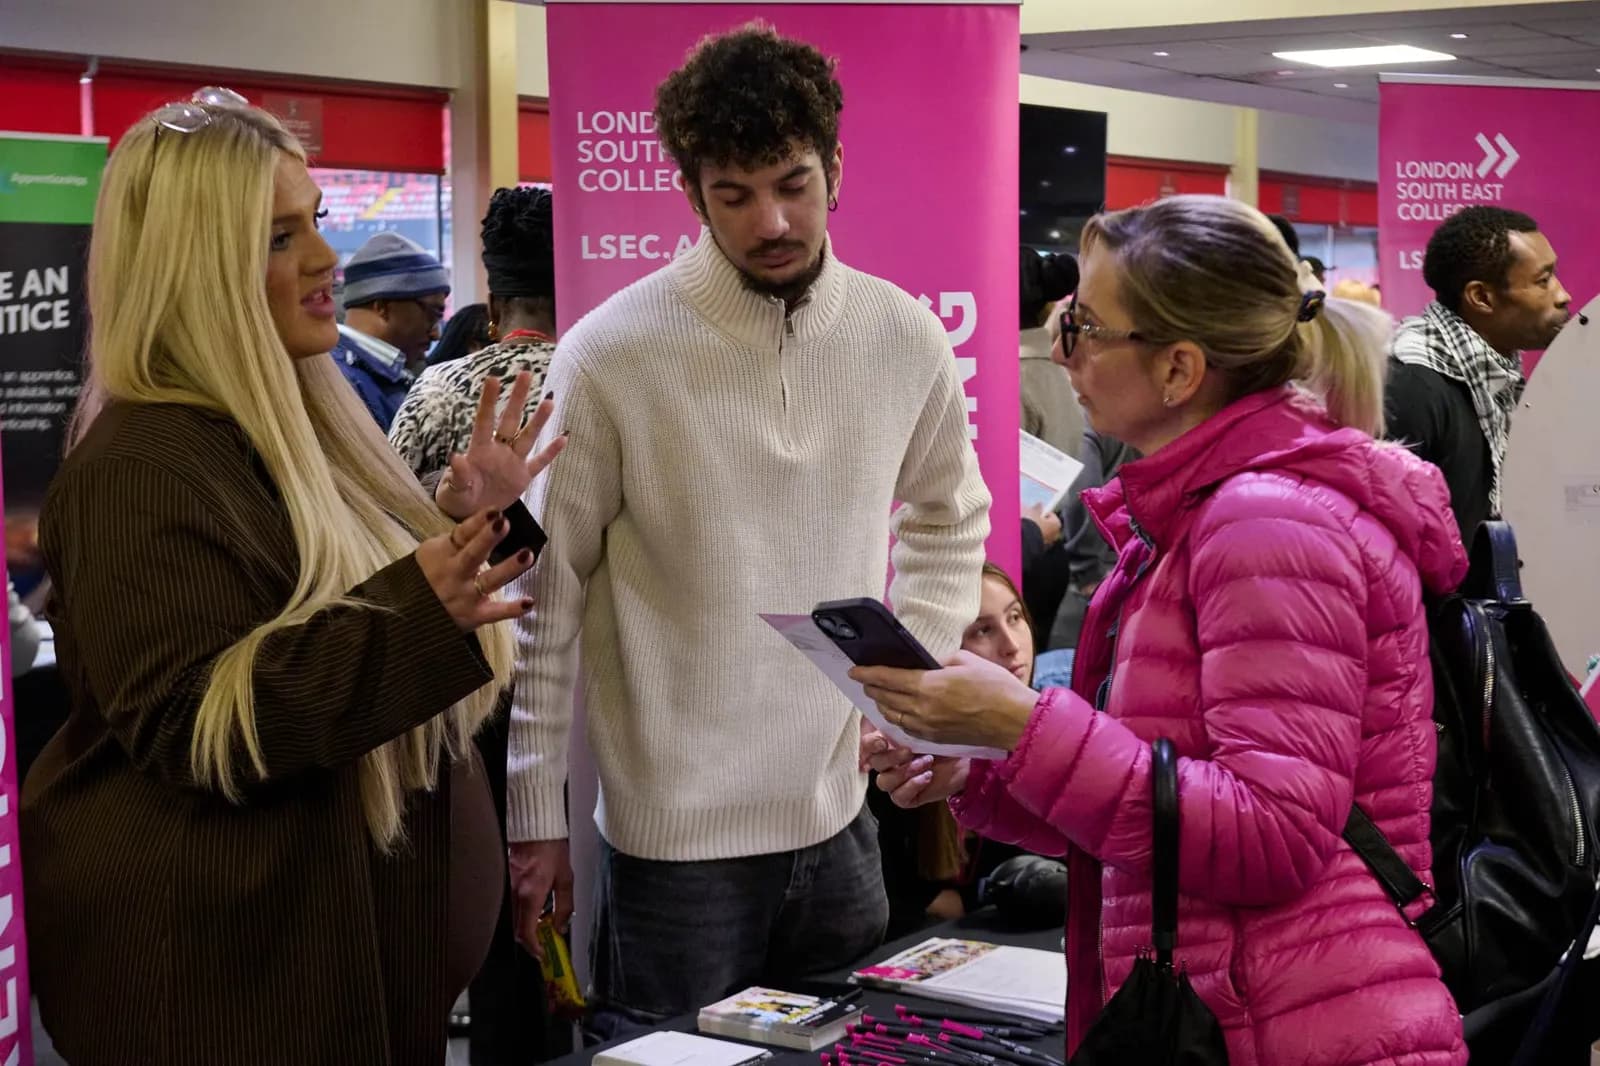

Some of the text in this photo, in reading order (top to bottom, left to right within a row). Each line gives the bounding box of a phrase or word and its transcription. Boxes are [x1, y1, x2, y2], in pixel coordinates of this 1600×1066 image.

[577, 111, 657, 134] LOND
[578, 169, 684, 192] COLLE
[1396, 161, 1474, 179] LONDON
[1396, 182, 1504, 201] SOUTH EAST
[1397, 203, 1466, 221] COLLE
[581, 235, 695, 259] LSEC.A
[1399, 250, 1424, 270] LS
[0, 266, 69, 301] E AN
